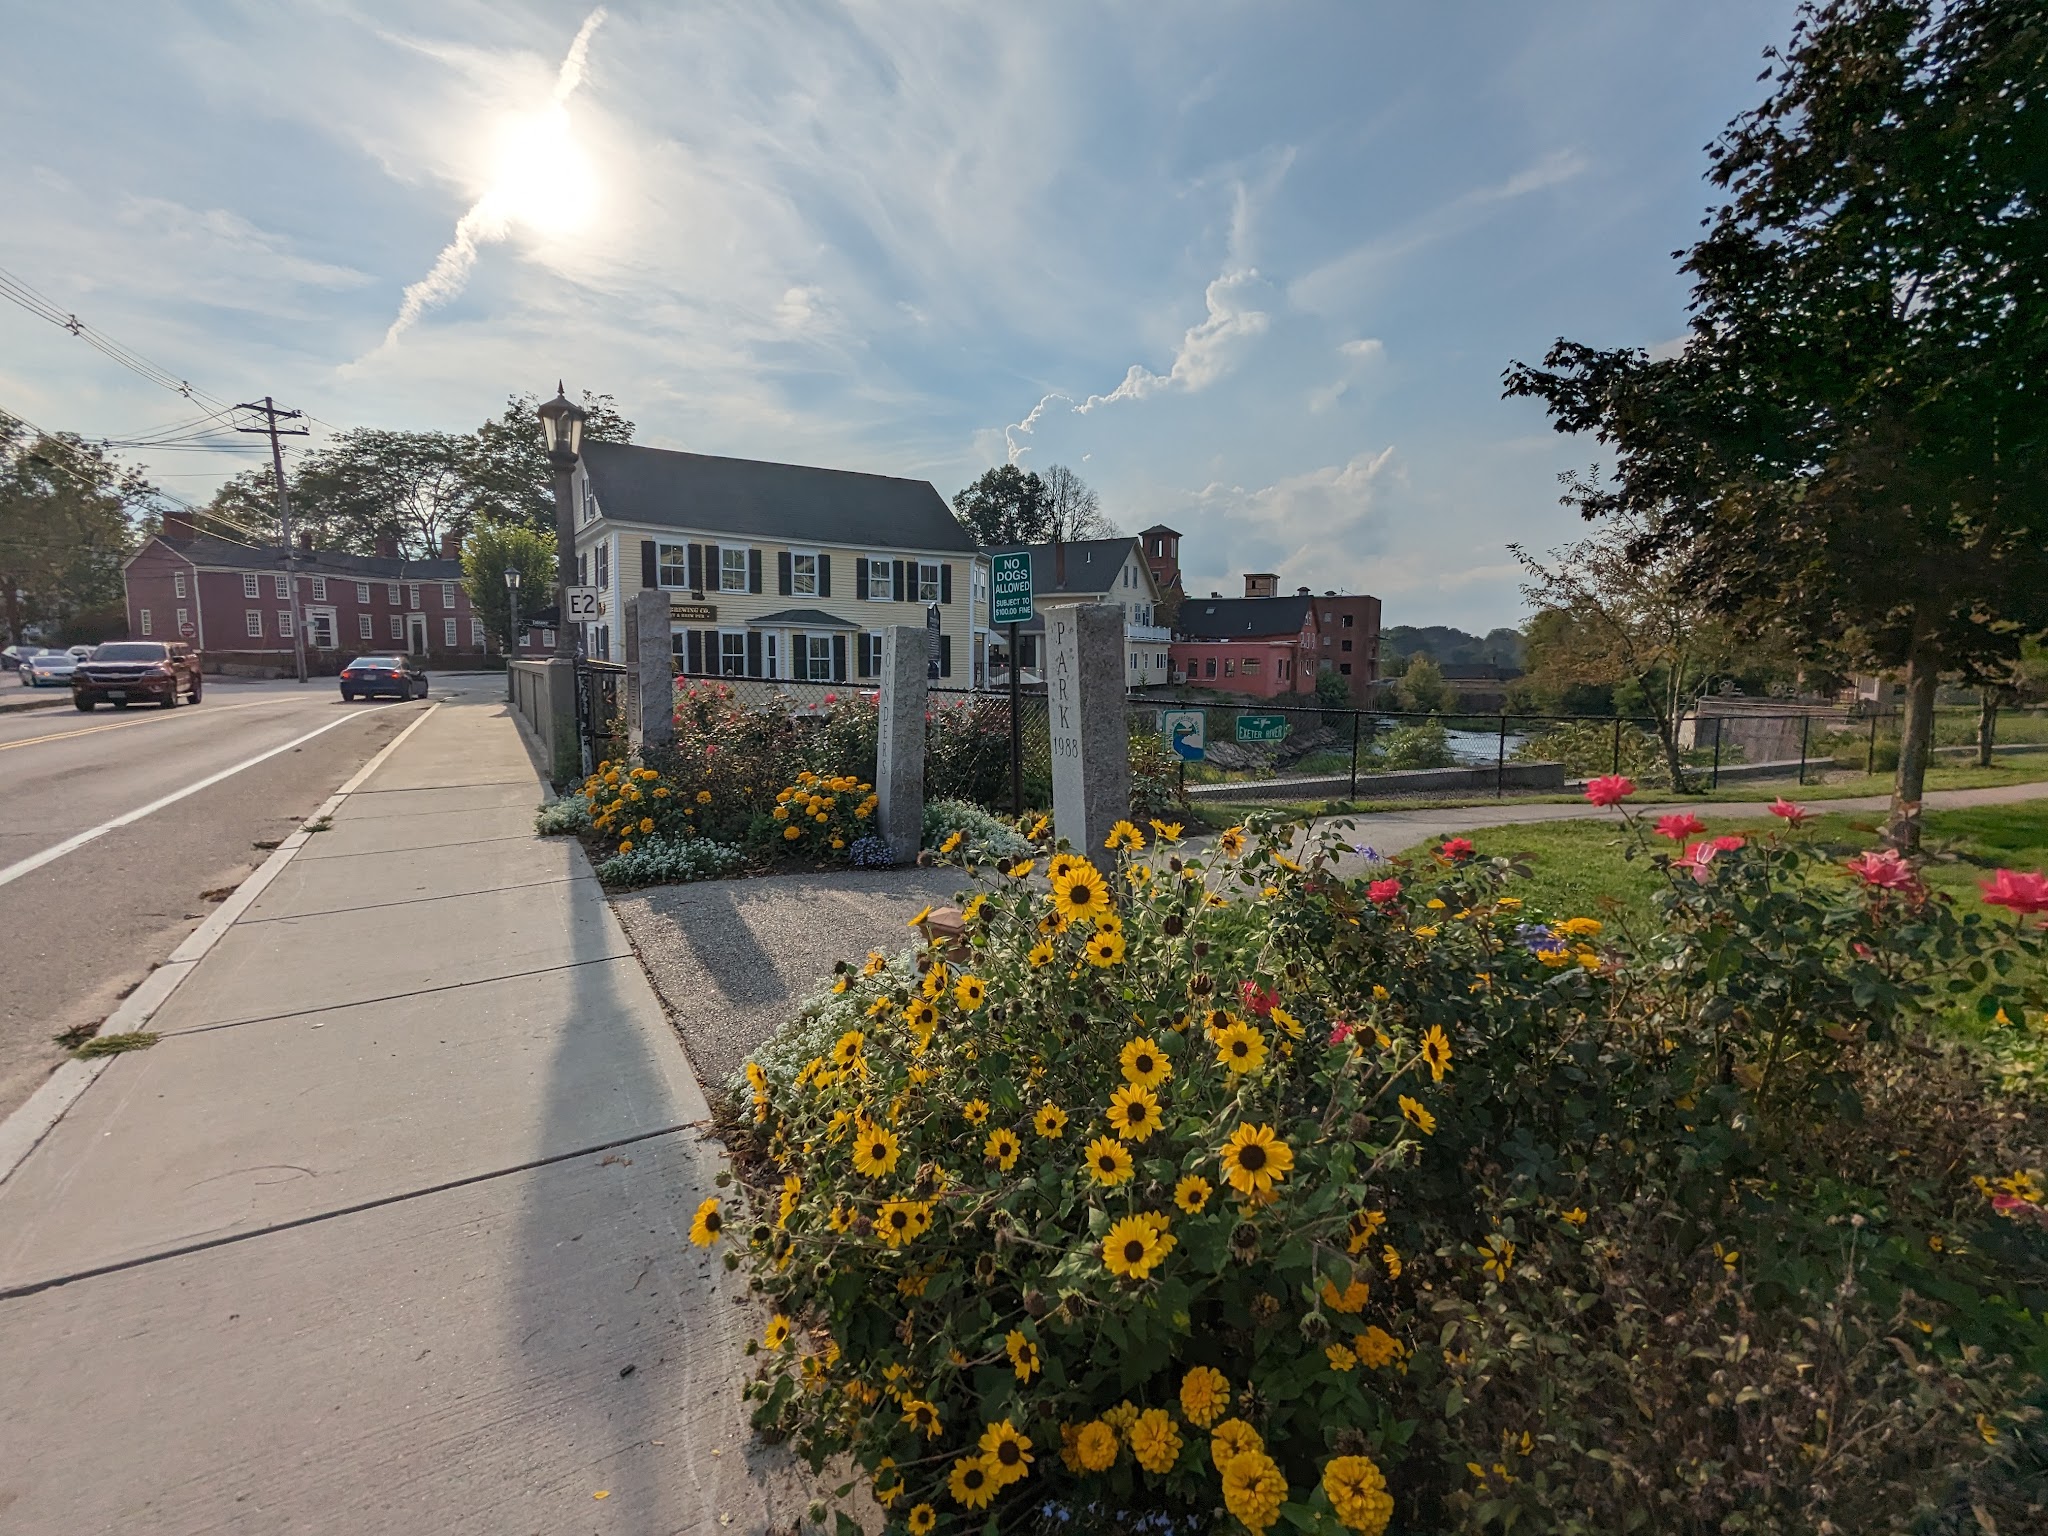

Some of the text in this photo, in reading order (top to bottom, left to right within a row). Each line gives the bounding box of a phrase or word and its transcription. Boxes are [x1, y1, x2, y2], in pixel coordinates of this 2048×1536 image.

[1004, 559, 1020, 569] NO
[997, 569, 1028, 581] DOGS
[995, 581, 1030, 593] ALLOWED
[570, 594, 595, 614] E2
[996, 597, 1030, 607] SUBJECT TO
[995, 606, 1031, 616] $100.00 FINE
[1057, 621, 1070, 729] PARK
[881, 634, 891, 775] FOUNDERS
[1239, 724, 1283, 739] EXETER RIVER
[1053, 736, 1079, 759] 1988
